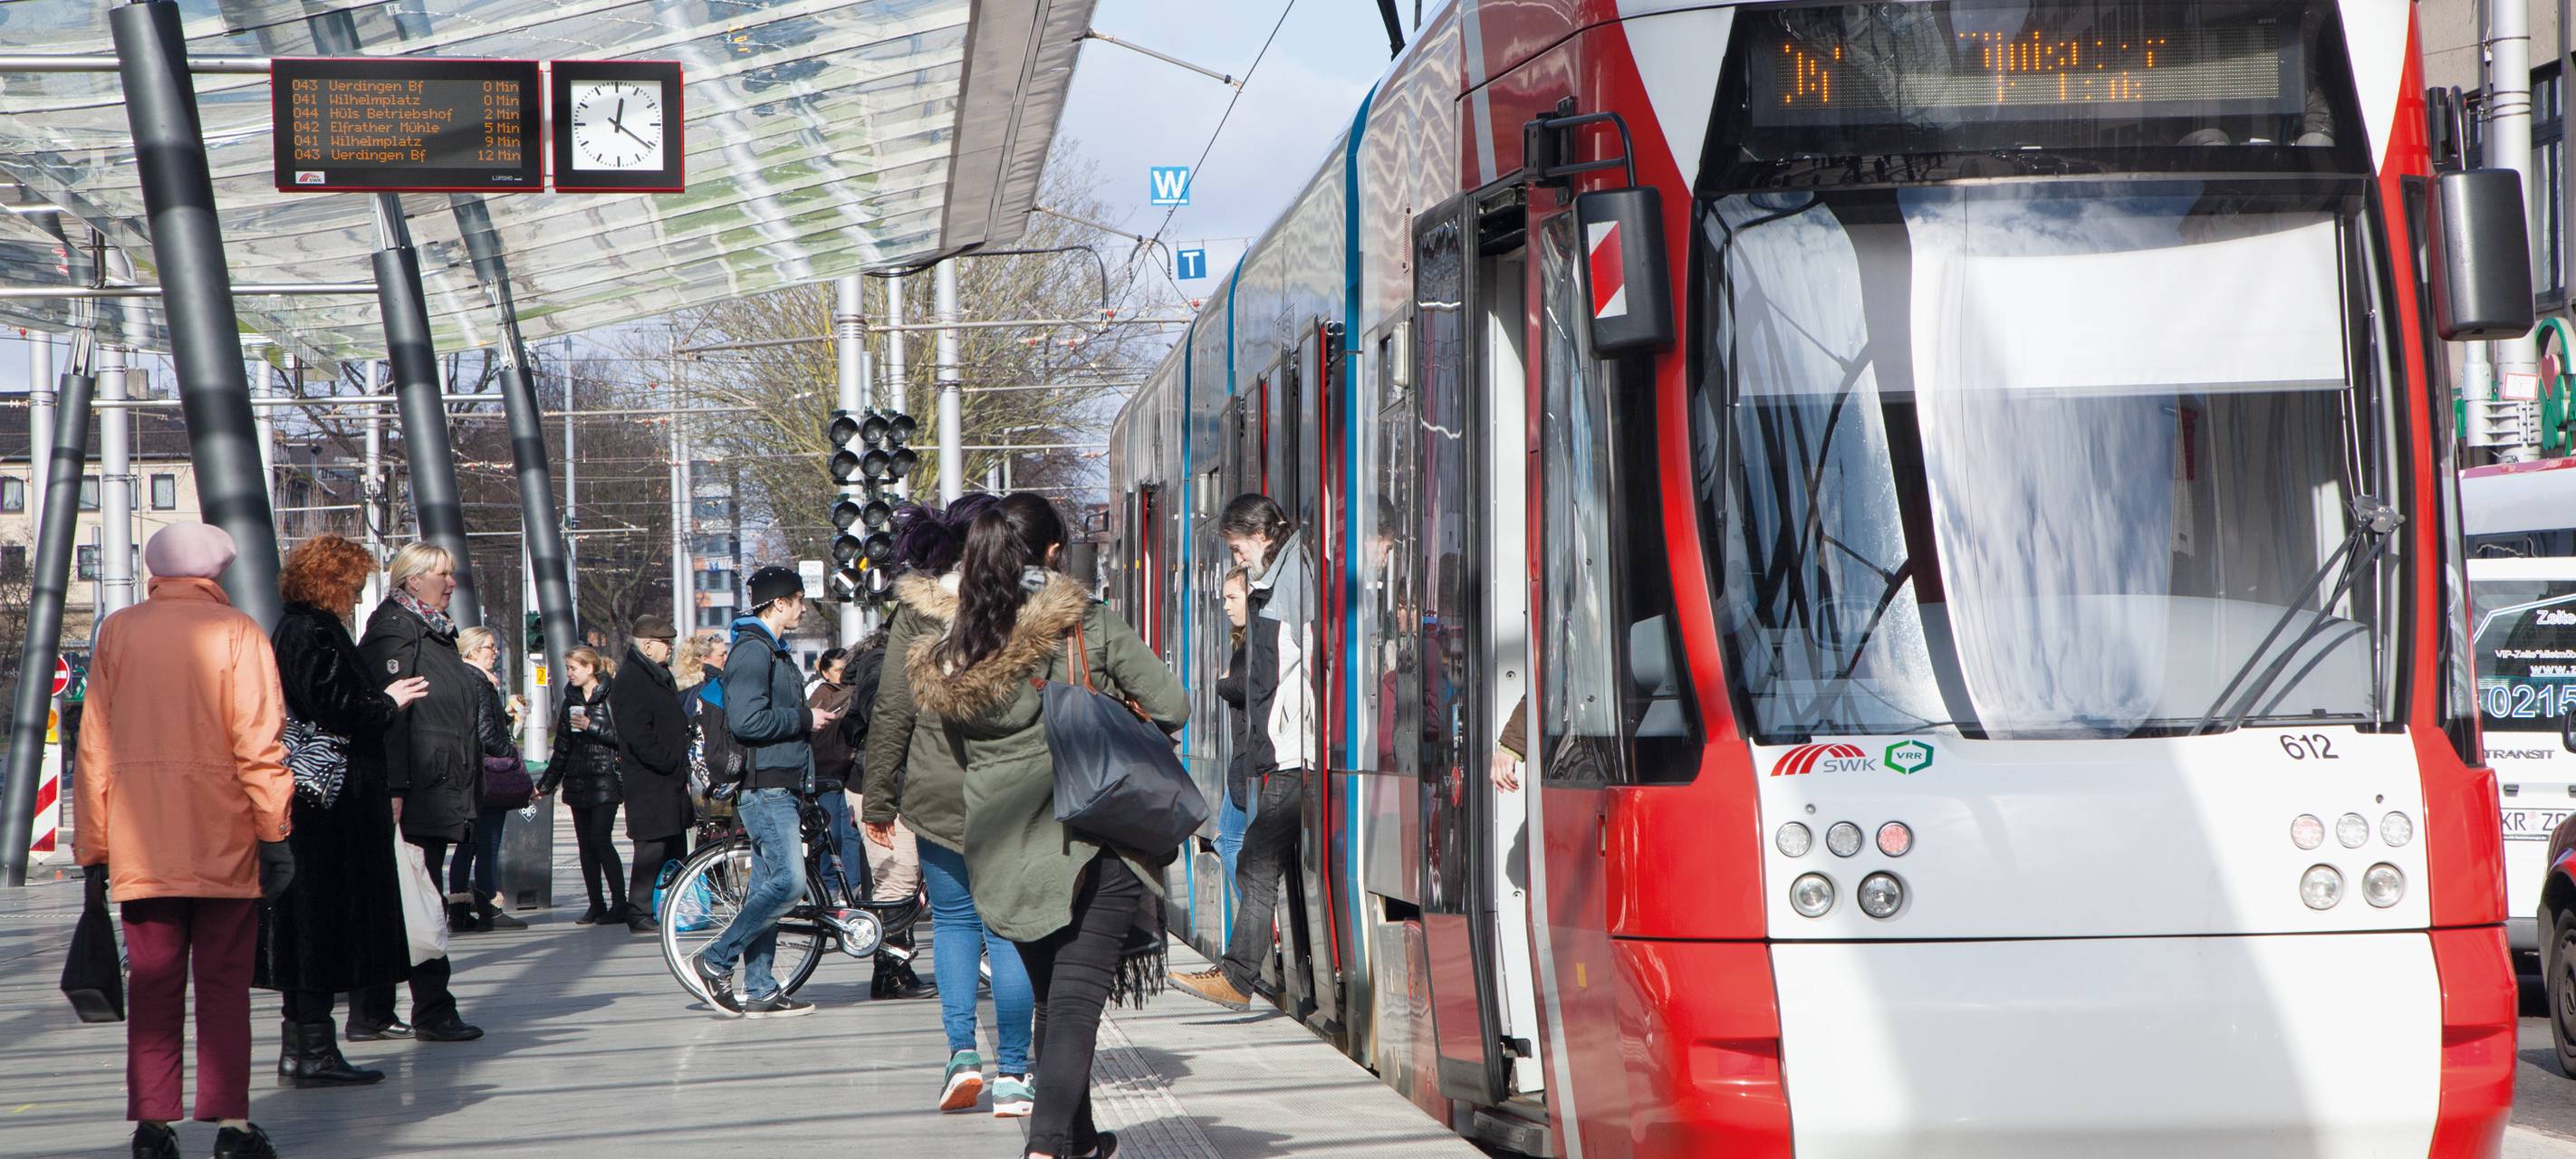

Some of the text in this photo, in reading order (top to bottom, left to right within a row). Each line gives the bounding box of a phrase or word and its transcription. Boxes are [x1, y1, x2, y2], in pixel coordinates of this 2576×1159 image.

[292, 79, 519, 94] 043 Uerdingen Bf 0 Min
[293, 93, 519, 107] 041 Wilhelmplatz 0 Min
[293, 107, 520, 121] 044 Hüls Betriebshof 2 Min
[293, 121, 520, 135] 042 Elfrather Mühle 5 Min
[293, 135, 521, 148] 041 Wilhelmplatz 9 Min
[294, 148, 522, 163] 043 Uerdingen Bf 12 Min
[1152, 170, 1187, 199] W
[1182, 251, 1200, 277] T
[538, 669, 545, 682] 2
[2280, 733, 2340, 761] 612
[1896, 752, 1923, 760] VRR
[2484, 749, 2556, 760] TRANSIT
[1822, 758, 1878, 773] SWK
